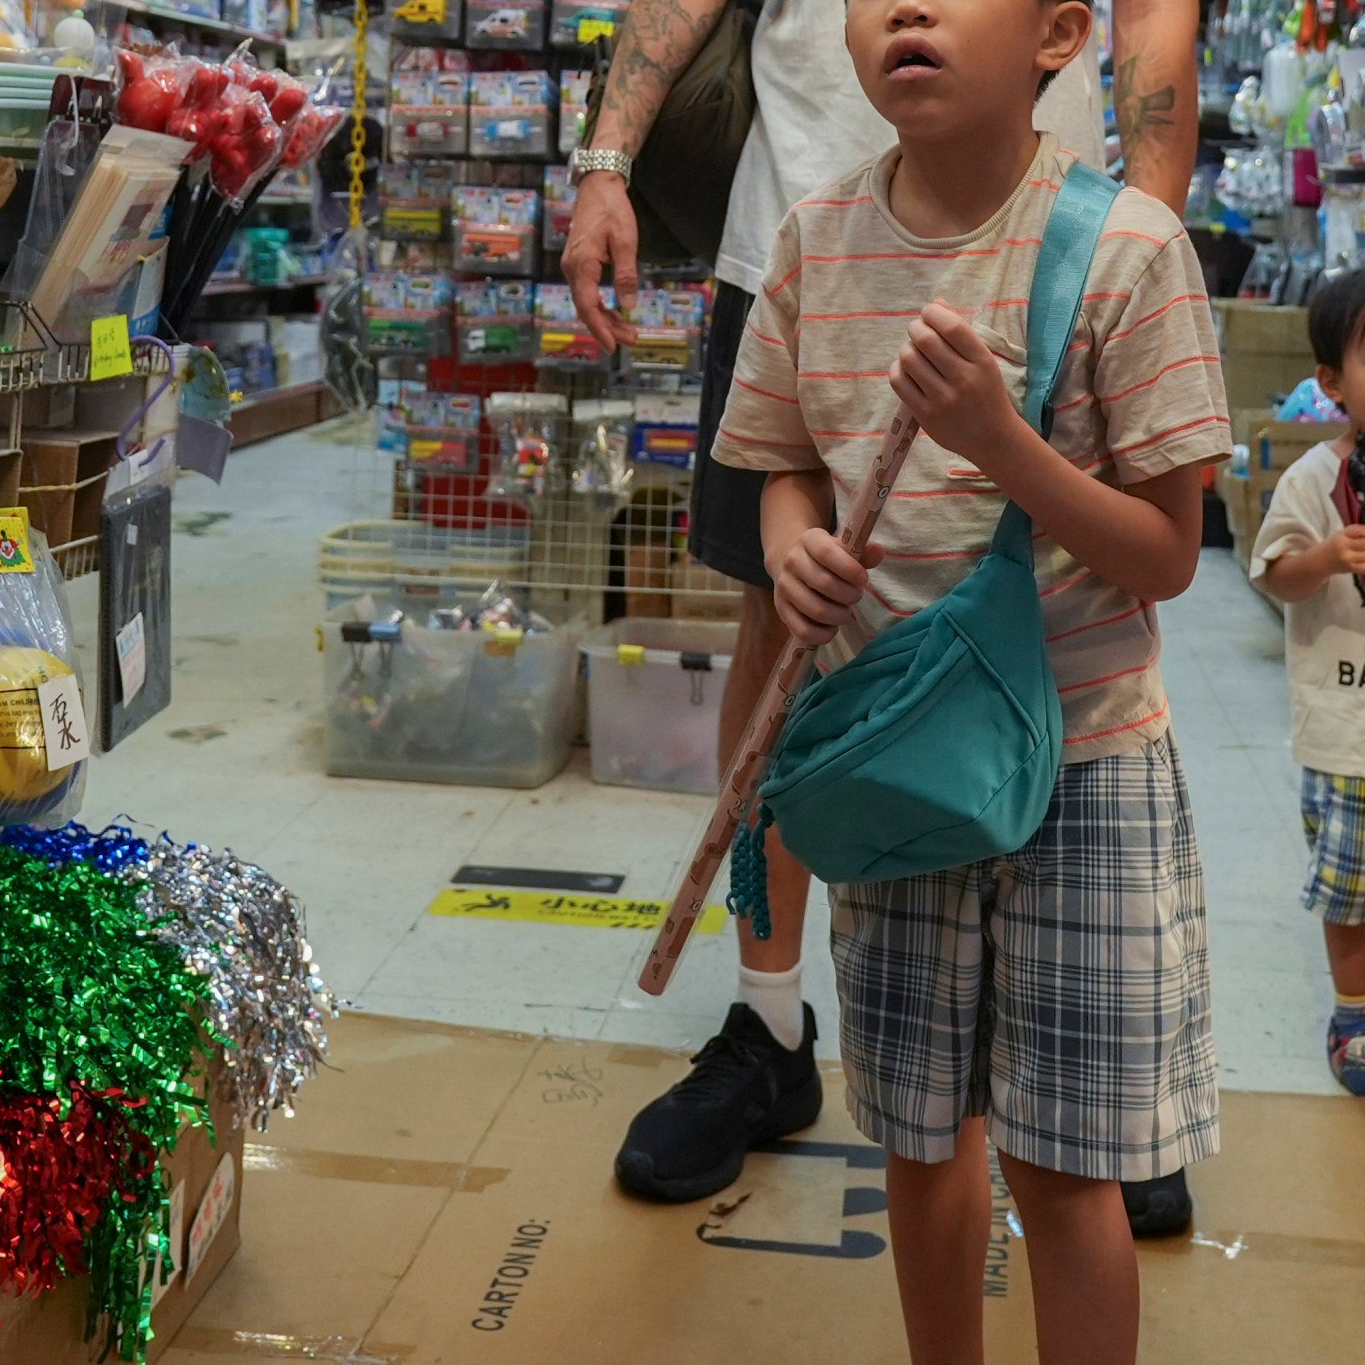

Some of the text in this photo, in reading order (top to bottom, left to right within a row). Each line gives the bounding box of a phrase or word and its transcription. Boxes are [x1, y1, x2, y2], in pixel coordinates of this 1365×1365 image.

[471, 1217, 553, 1334] CARTON NO:
[981, 1246, 1009, 1299] MADE
